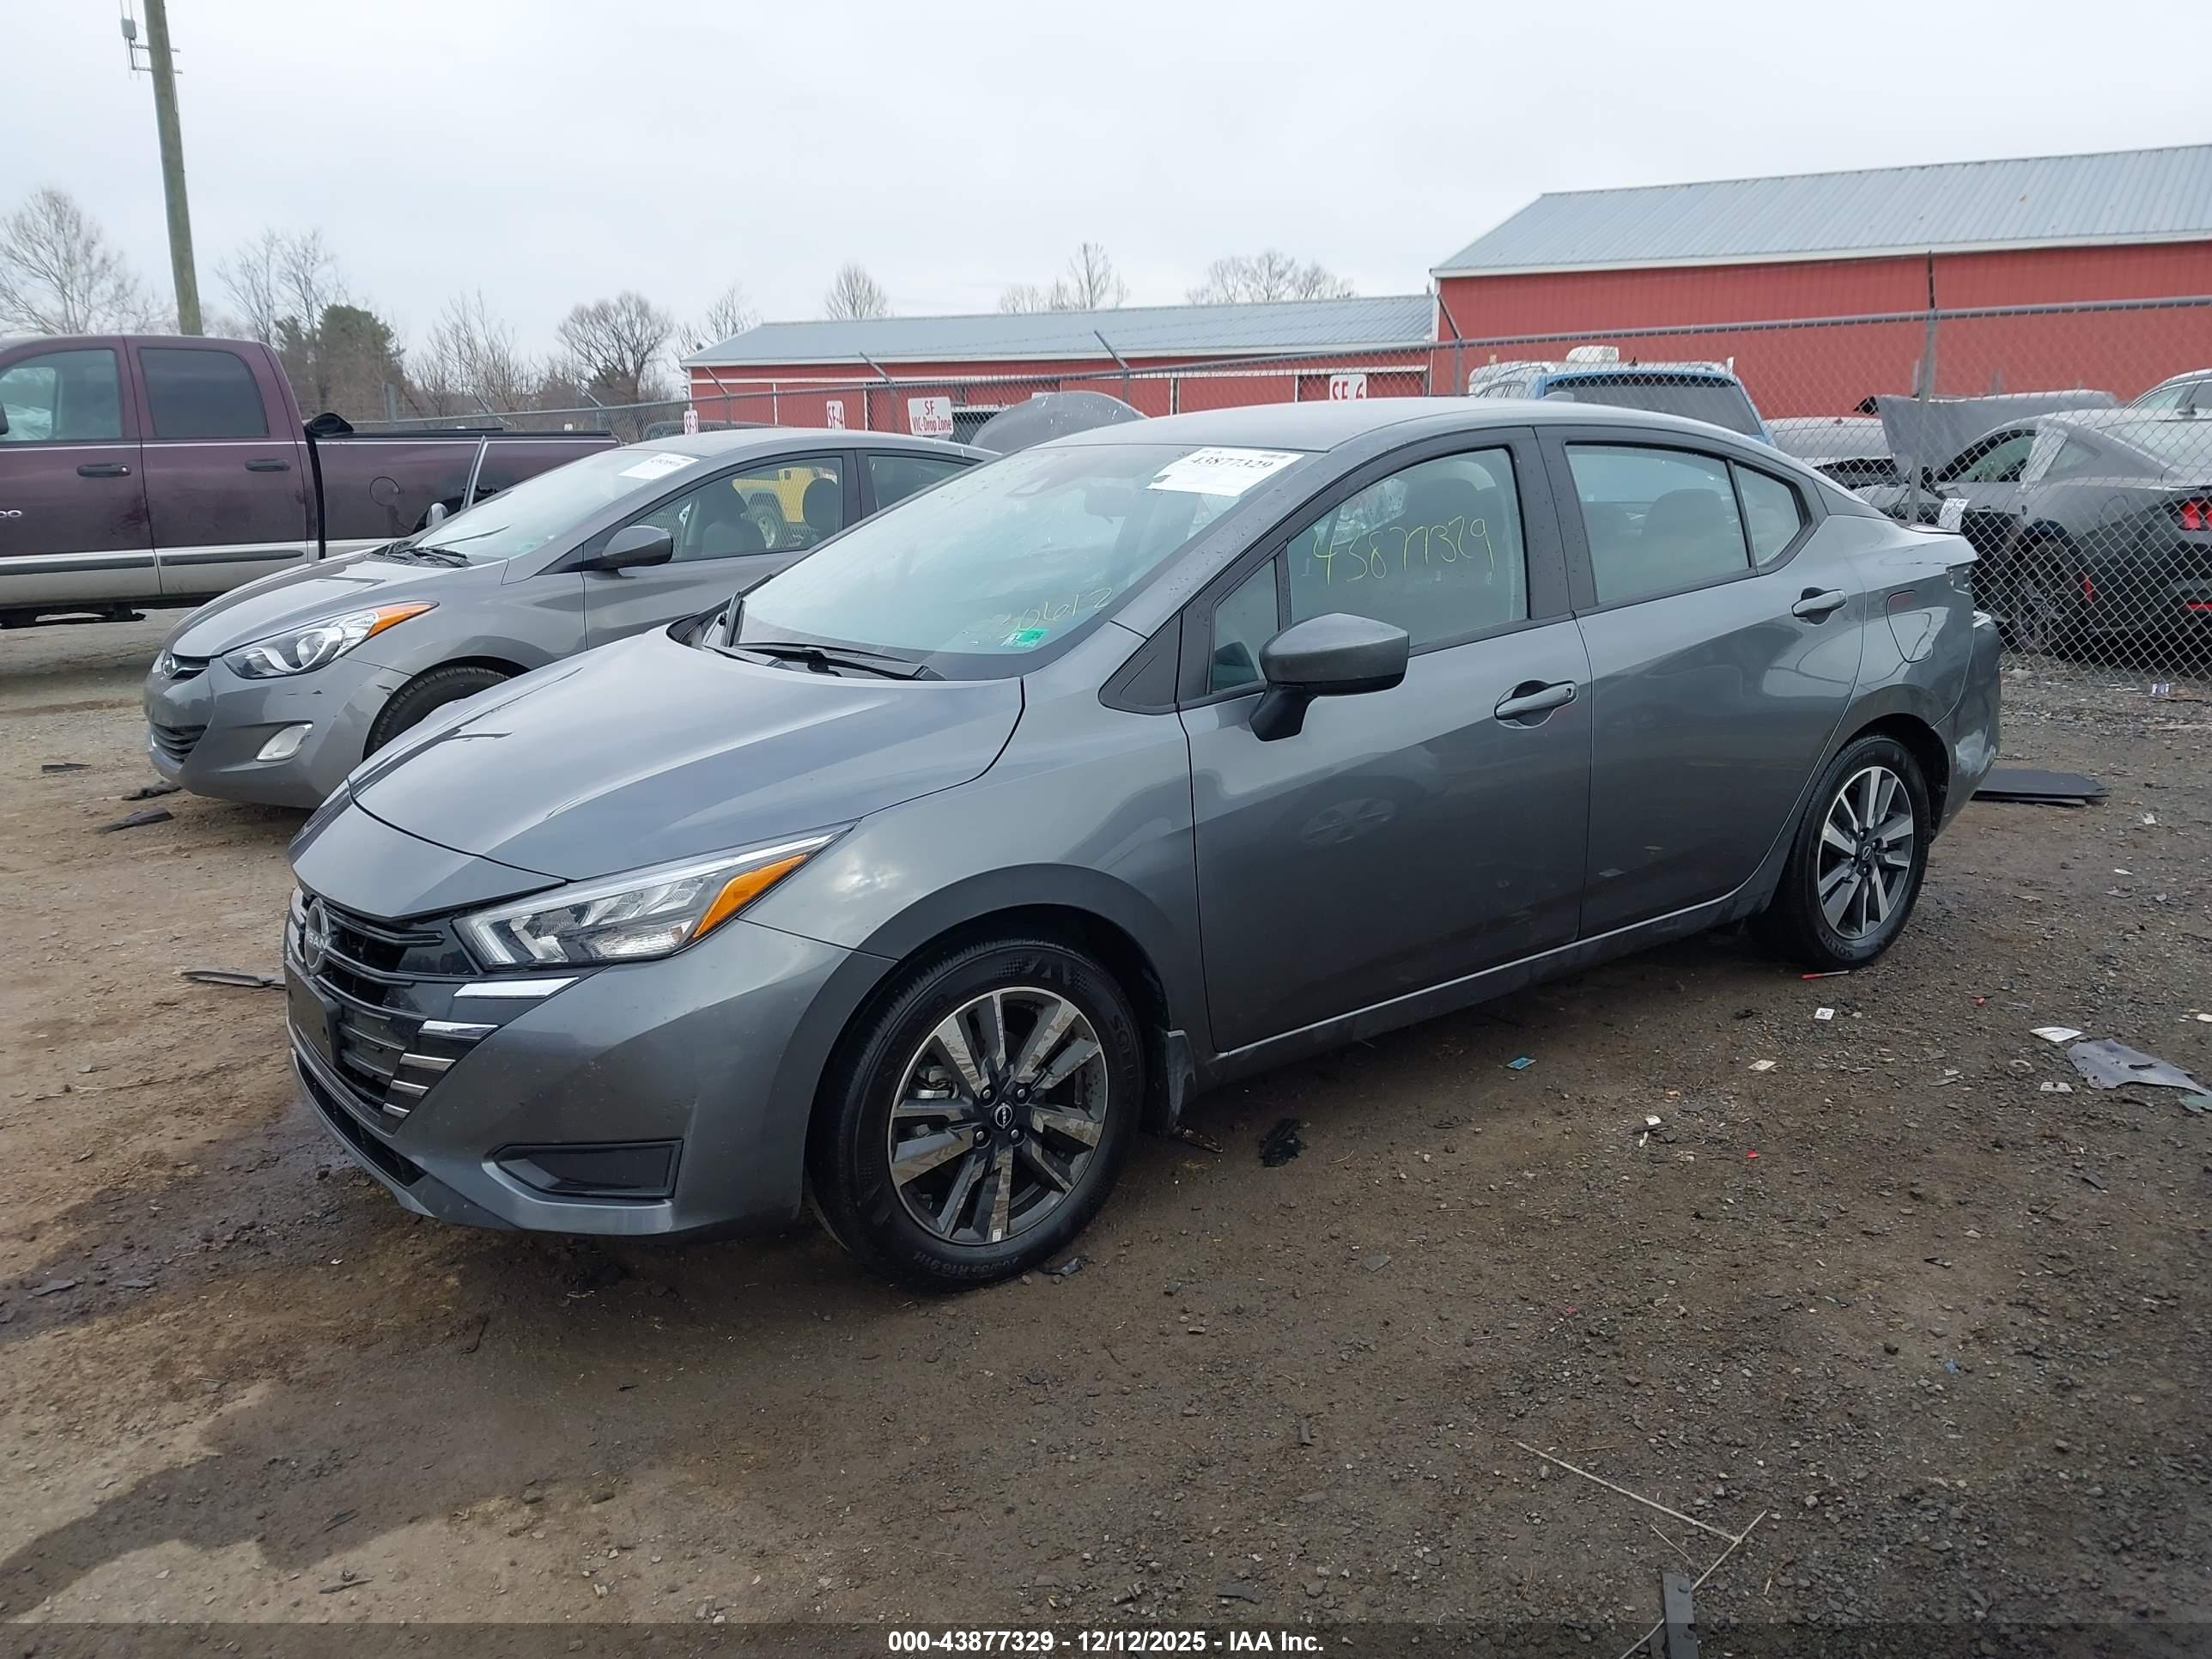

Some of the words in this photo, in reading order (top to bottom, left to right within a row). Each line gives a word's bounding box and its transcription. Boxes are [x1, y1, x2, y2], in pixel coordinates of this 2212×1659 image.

[1333, 380, 1364, 399] SF6
[828, 405, 844, 429] SF-4
[924, 400, 935, 416] SF
[913, 416, 937, 433] VIC-Drop
[938, 416, 951, 431] Zone
